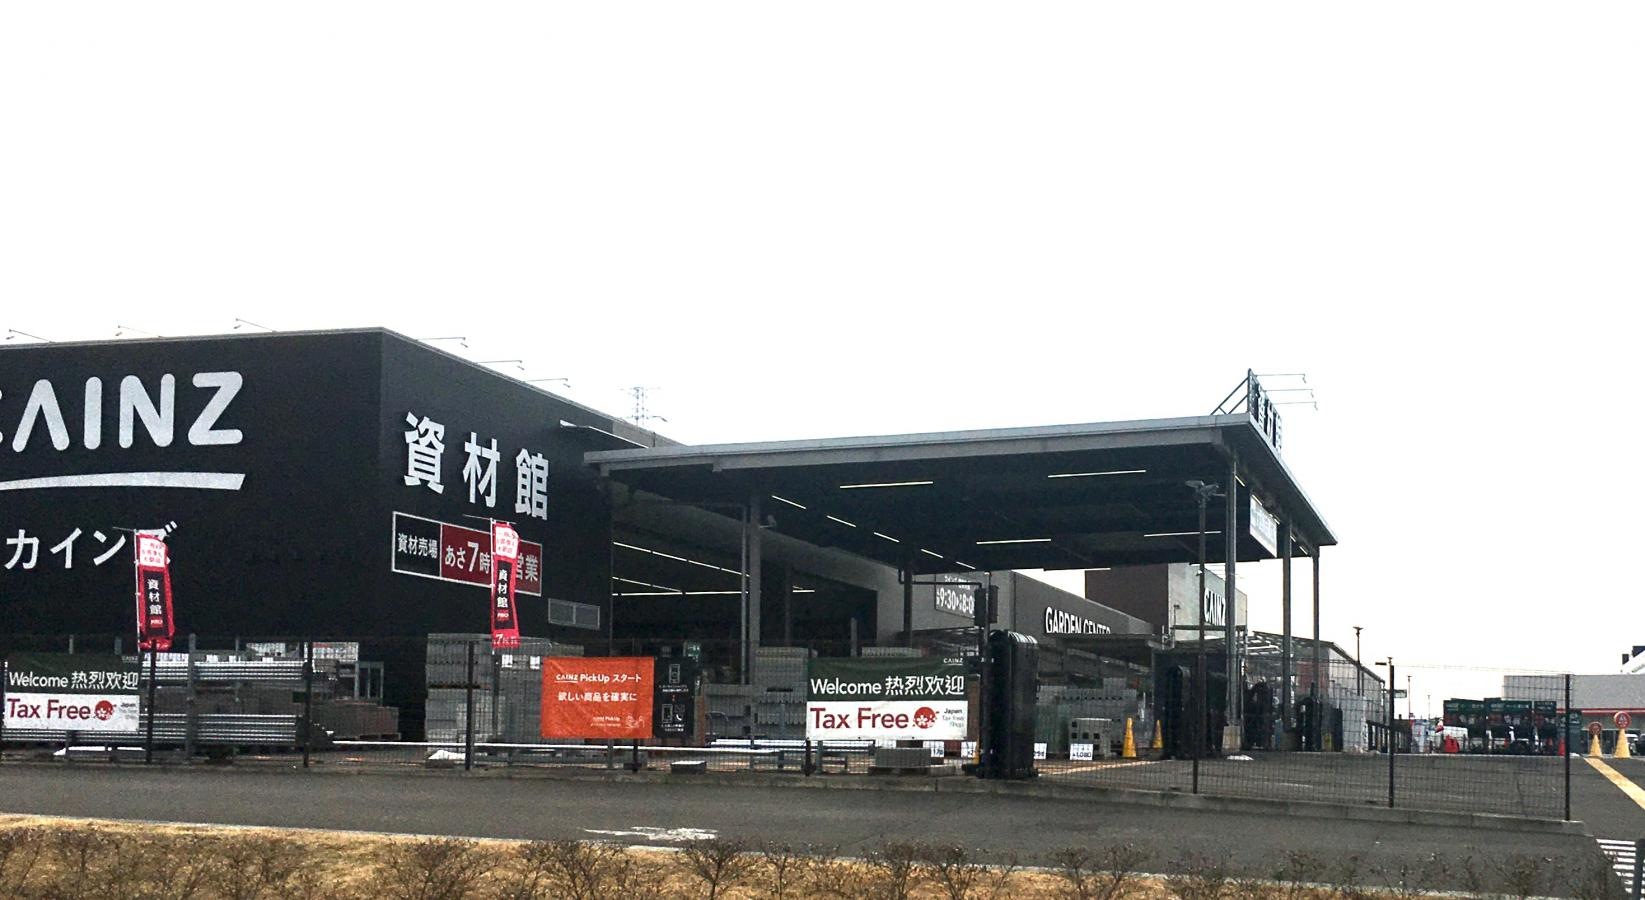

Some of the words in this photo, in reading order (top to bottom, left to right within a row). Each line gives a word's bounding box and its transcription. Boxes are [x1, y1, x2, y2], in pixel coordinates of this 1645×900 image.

[0, 371, 243, 452] AINZ
[404, 411, 549, 520] 資材館
[398, 532, 438, 559] 資材売場
[1045, 606, 1082, 634] GARDEN
[9, 671, 69, 687] Welcome
[71, 670, 139, 690] 热烈欢迎
[580, 673, 610, 684] PickUp
[613, 674, 642, 683] スタート
[811, 678, 882, 695] Welcome
[885, 675, 965, 696] 热烈欢迎
[7, 698, 41, 718] Tax
[47, 699, 91, 720] Free
[810, 707, 851, 729] Tax
[858, 708, 909, 729] Free
